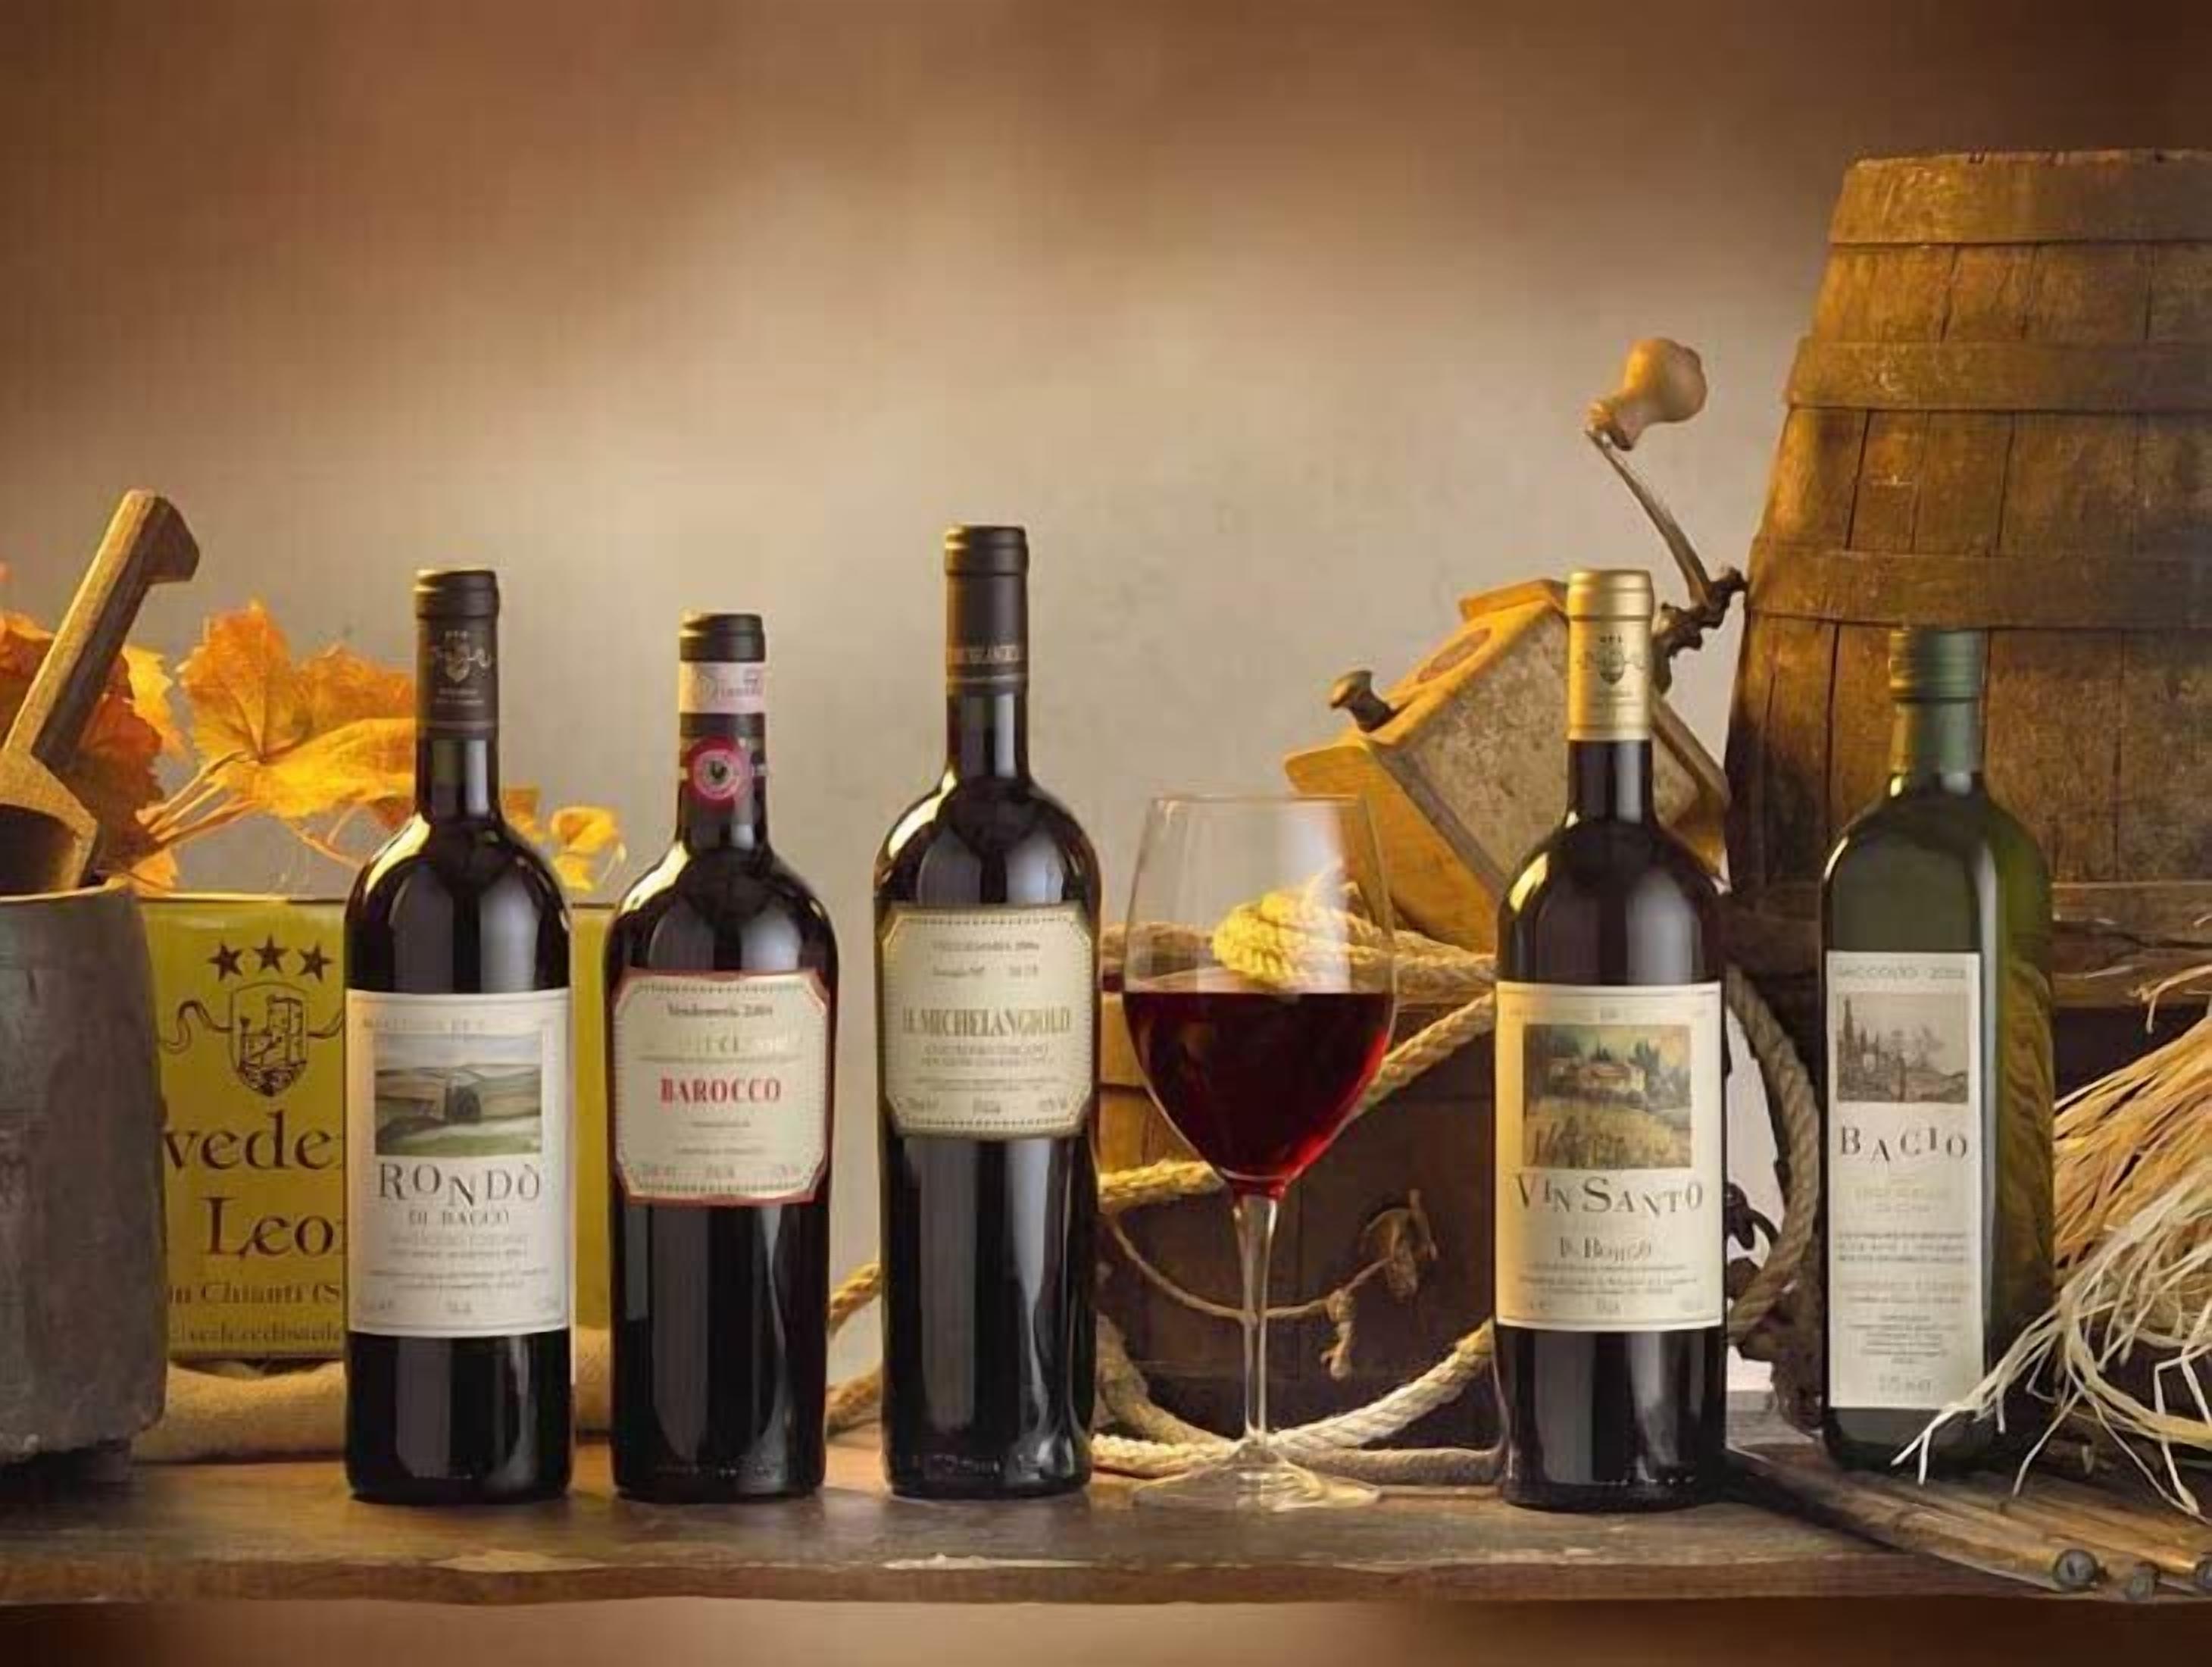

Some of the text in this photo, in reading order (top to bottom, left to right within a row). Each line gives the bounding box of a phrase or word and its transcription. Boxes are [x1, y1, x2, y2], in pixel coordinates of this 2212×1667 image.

[660, 1077, 781, 1103] BAROCCO
[164, 1109, 345, 1170] vede
[1842, 1125, 1967, 1164] BACIO
[379, 1162, 541, 1208] RONDÒ
[200, 1195, 345, 1258] Leo
[311, 1284, 340, 1304] (S
